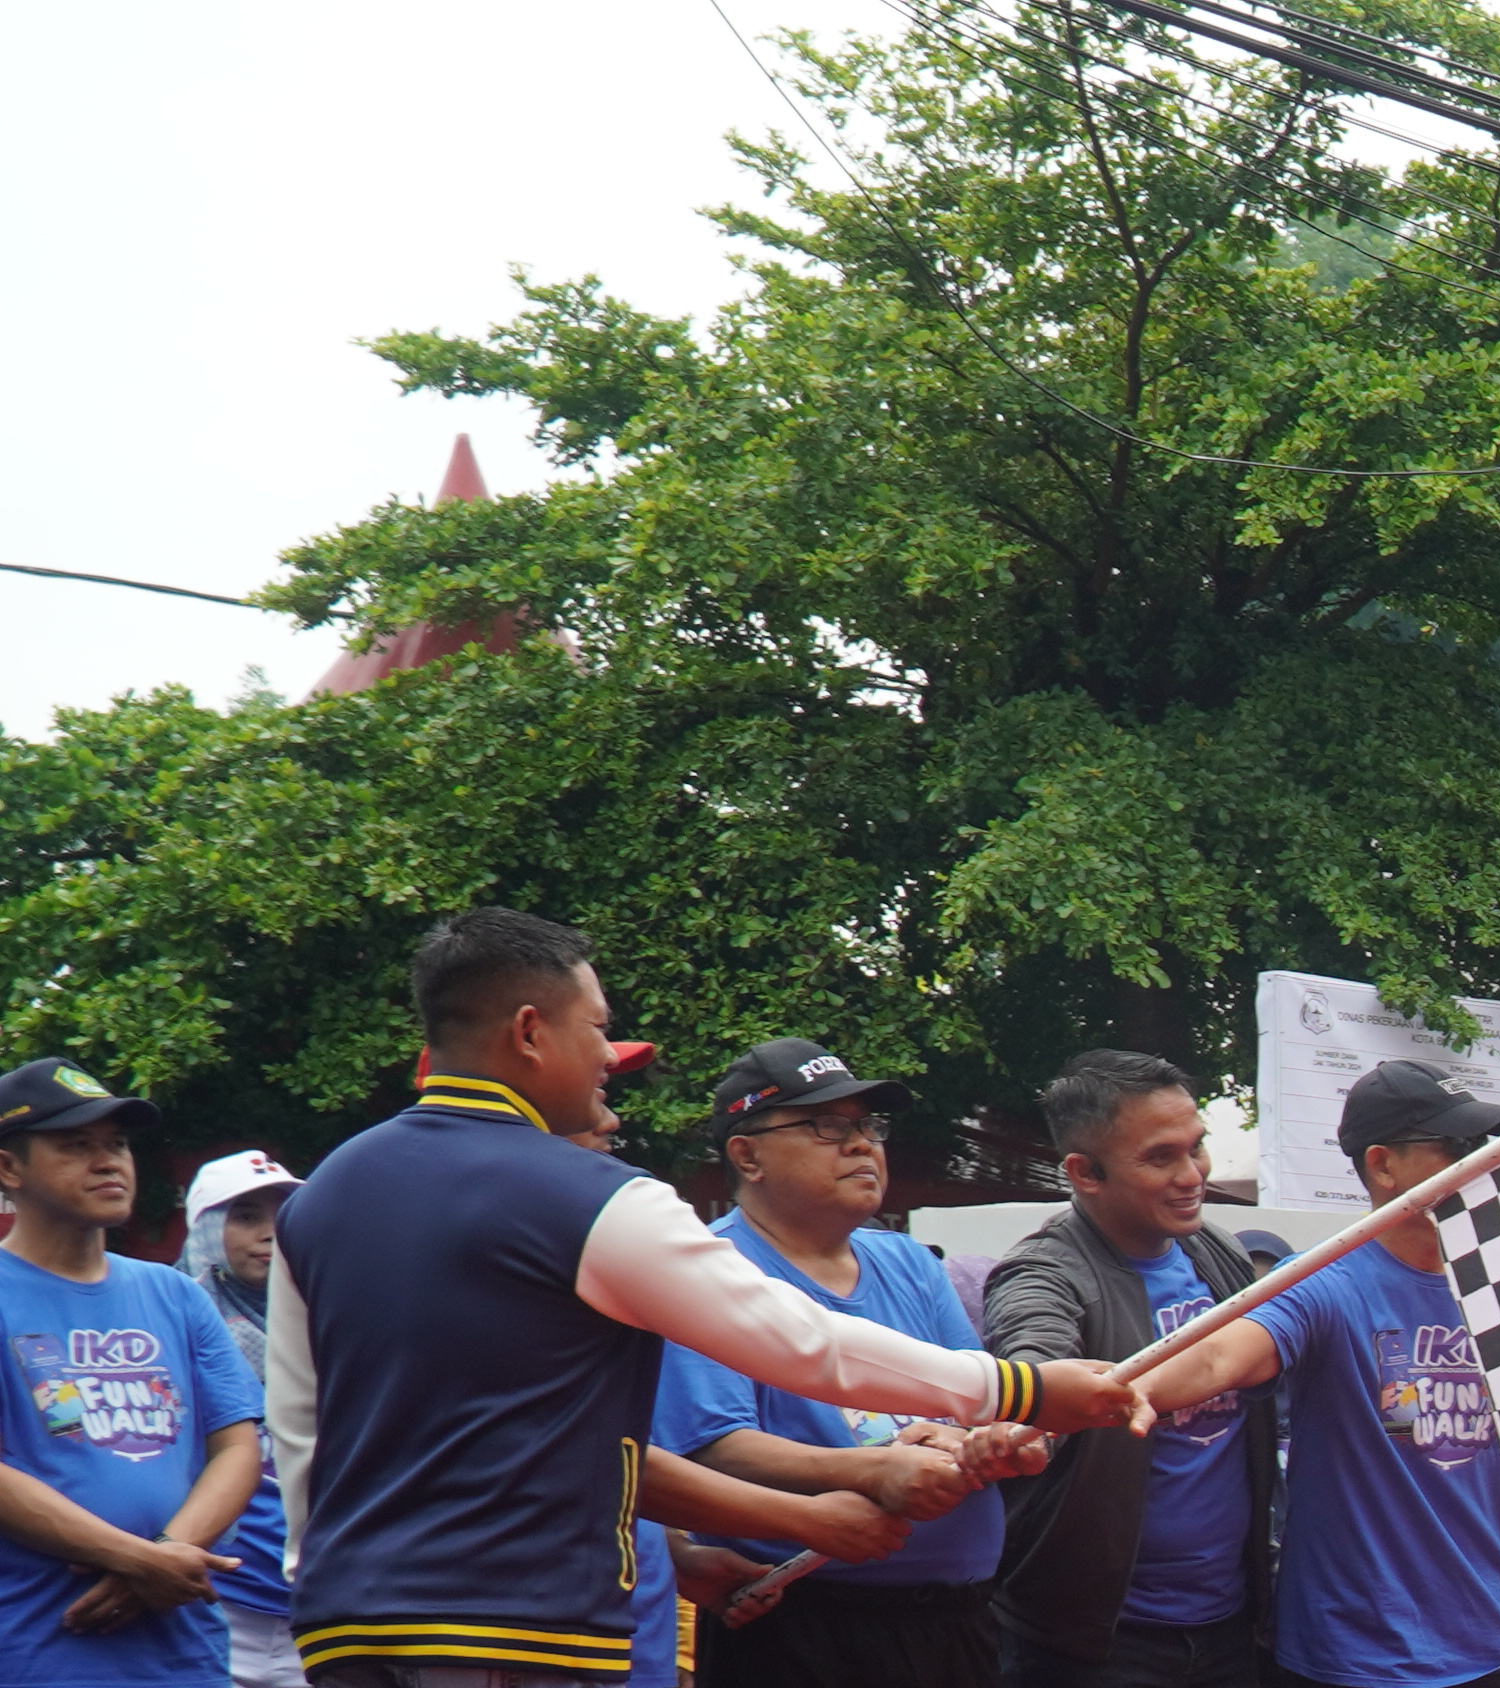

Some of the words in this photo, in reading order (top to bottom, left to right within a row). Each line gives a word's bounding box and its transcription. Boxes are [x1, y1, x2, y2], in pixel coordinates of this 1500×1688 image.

[1337, 1012, 1365, 1023] DINAS
[1367, 1015, 1413, 1029] PEKERJAAN
[1411, 1033, 1435, 1044] KOTA
[70, 1329, 159, 1367] IKD
[75, 1377, 152, 1410] FUN
[1416, 1377, 1481, 1413] FUN
[81, 1409, 174, 1440] WALK
[1413, 1412, 1493, 1448] WALK
